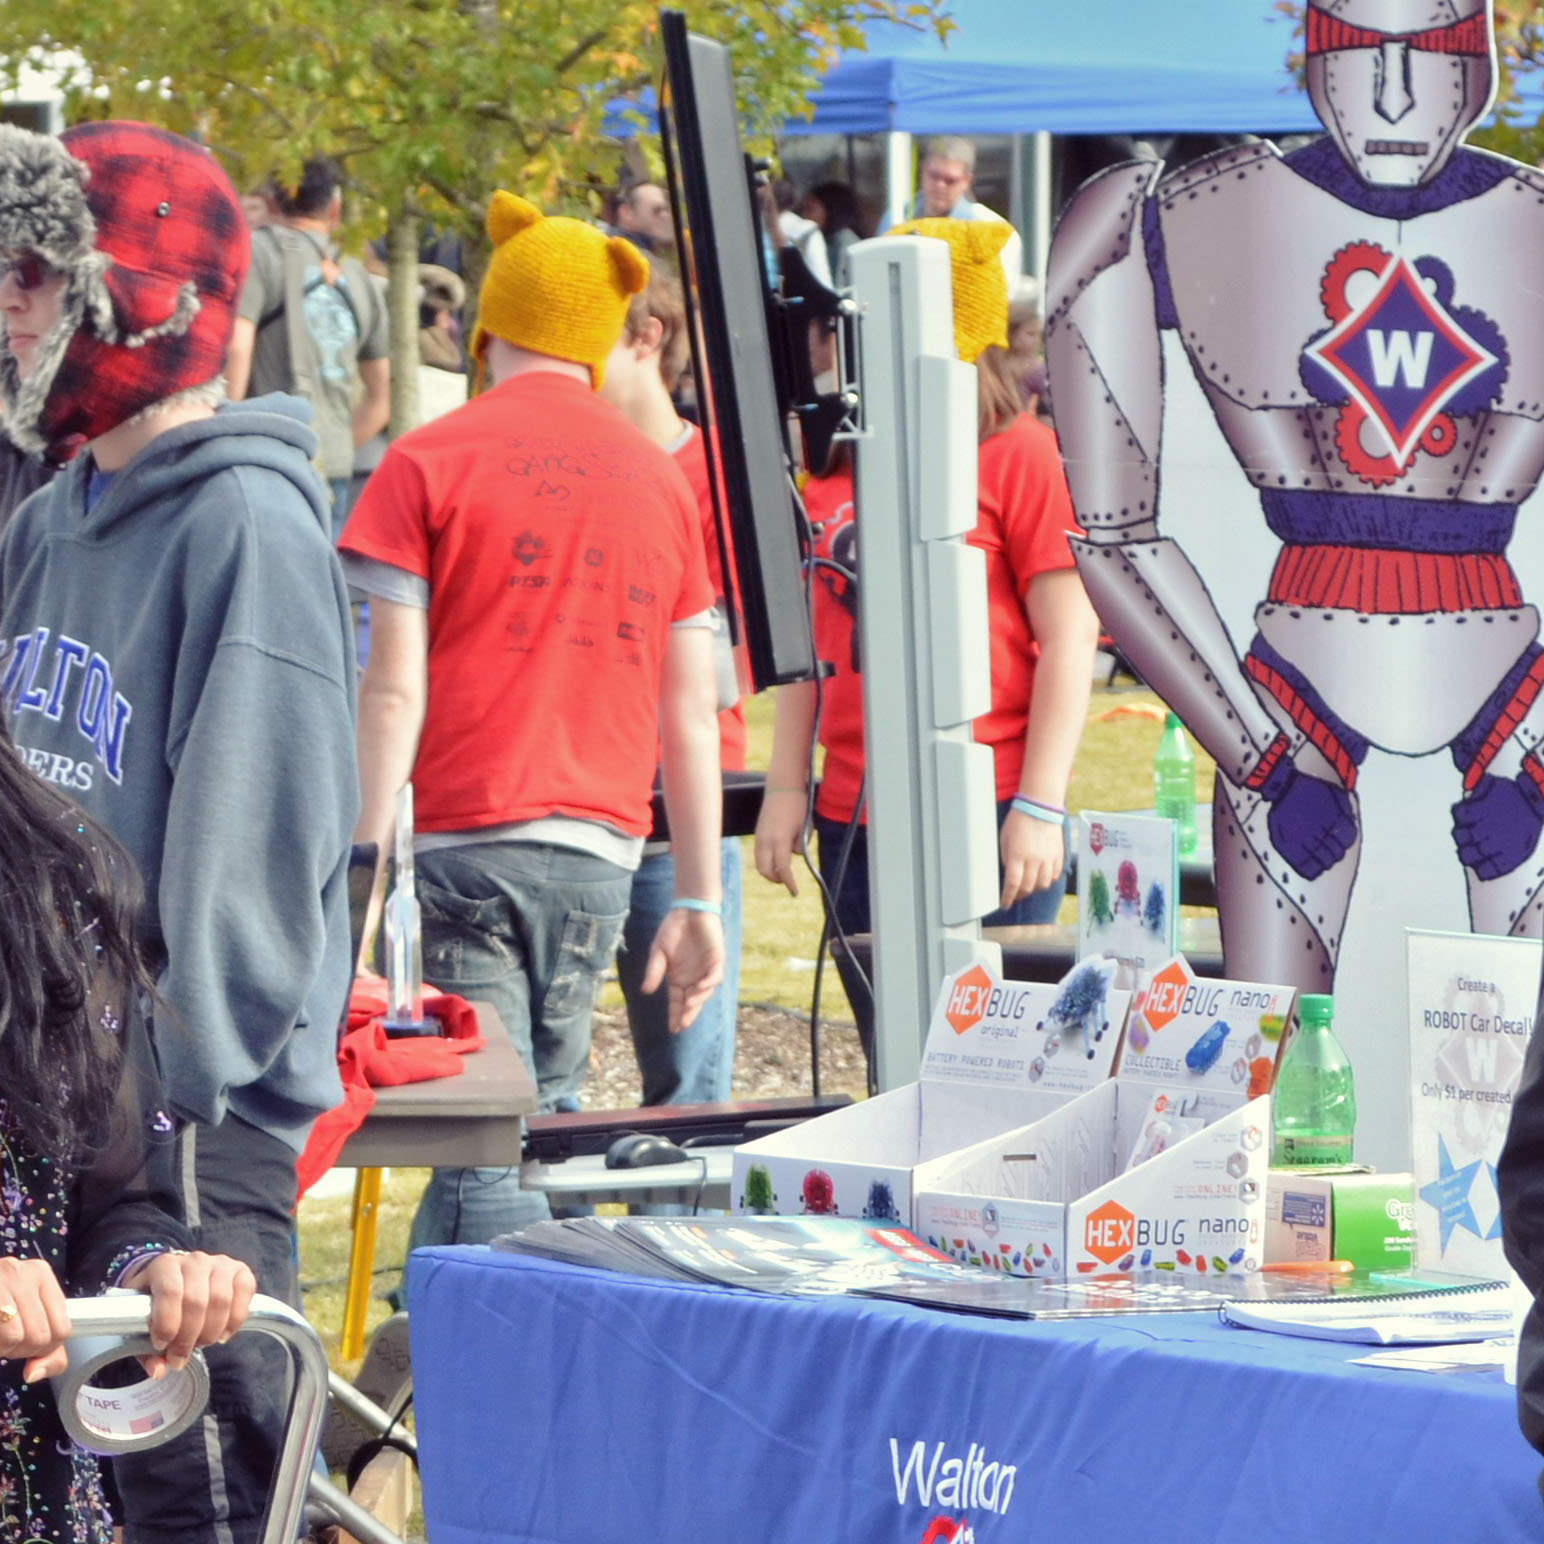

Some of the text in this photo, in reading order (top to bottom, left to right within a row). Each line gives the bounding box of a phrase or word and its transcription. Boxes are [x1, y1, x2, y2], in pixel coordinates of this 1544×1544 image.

[1367, 330, 1435, 389] W
[1457, 977, 1497, 993] Create a
[1230, 990, 1271, 1009] nano
[1424, 1009, 1467, 1031] ROBOT
[1471, 1013, 1490, 1033] Car
[1421, 1082, 1443, 1100] Only
[1458, 1088, 1474, 1103] per
[1476, 1089, 1512, 1105] created
[1199, 1218, 1249, 1234] nano
[85, 1395, 122, 1411] TAPE
[889, 1437, 1017, 1515] Walton
